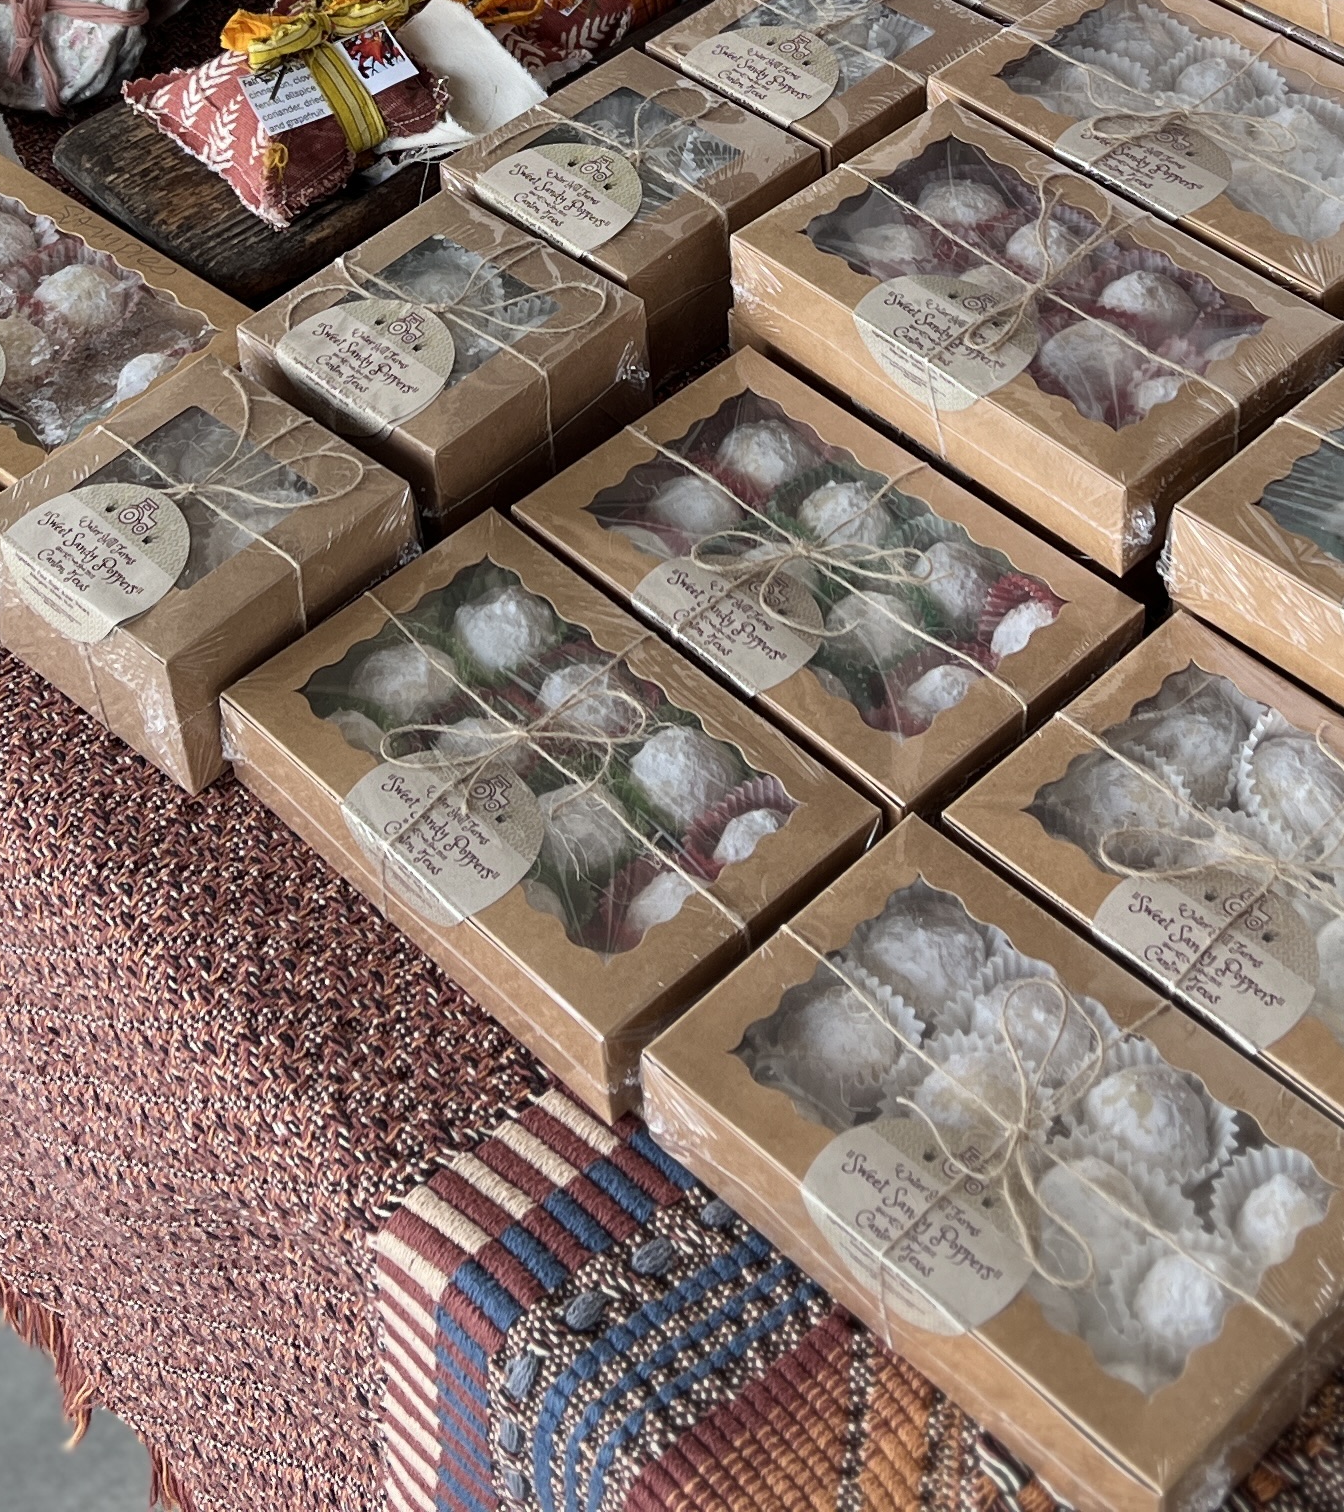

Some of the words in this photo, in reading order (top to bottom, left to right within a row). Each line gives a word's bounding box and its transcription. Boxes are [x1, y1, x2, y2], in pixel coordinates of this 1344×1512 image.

[736, 59, 770, 81] Sandy
[269, 122, 285, 132] and
[1113, 145, 1150, 169] Sandy
[534, 180, 568, 205] Sandy
[564, 198, 612, 228] Poppers"
[338, 342, 374, 369] Sandy
[368, 363, 420, 395] Poppers"
[62, 569, 91, 593] Texas
[63, 532, 98, 564] Sandy
[92, 556, 144, 595] Poppers"
[442, 834, 501, 881] Poppers"
[1214, 955, 1287, 1007] Poppers"
[840, 1149, 890, 1193] "Sweet
[929, 1225, 1003, 1282] Poppers"
[896, 1244, 937, 1278] Texas
